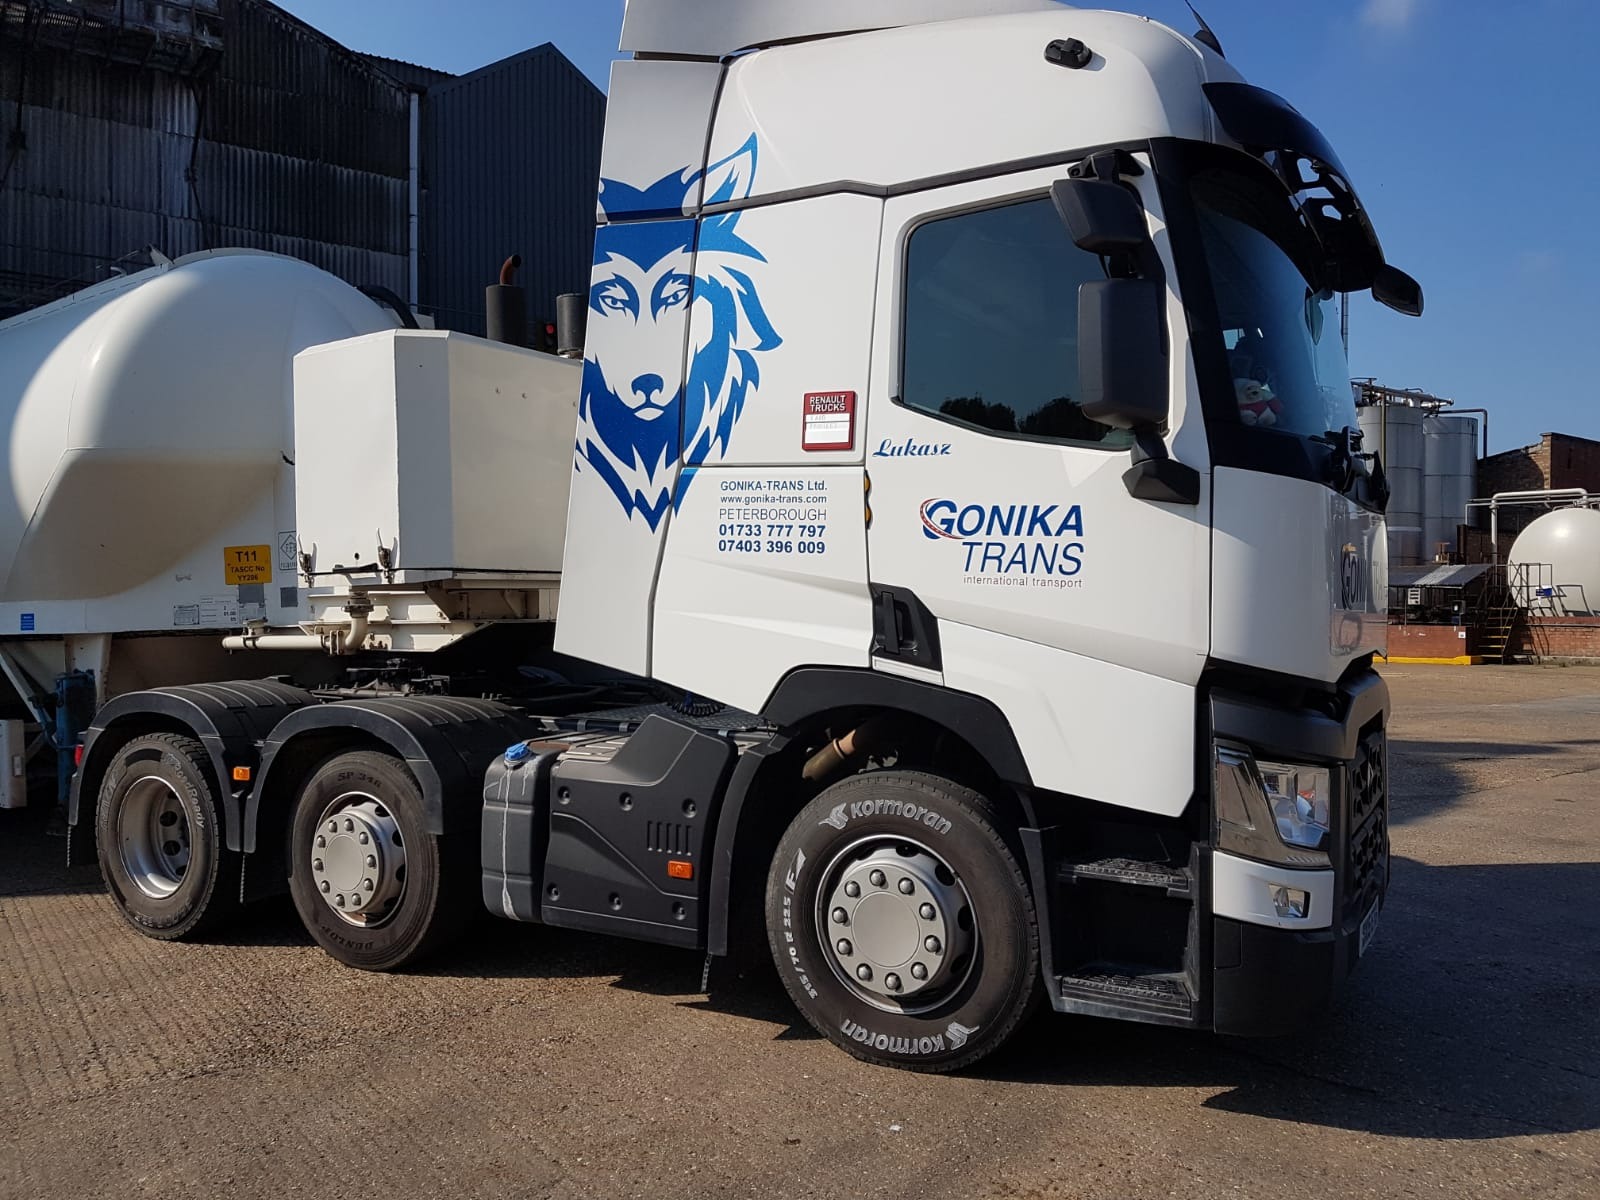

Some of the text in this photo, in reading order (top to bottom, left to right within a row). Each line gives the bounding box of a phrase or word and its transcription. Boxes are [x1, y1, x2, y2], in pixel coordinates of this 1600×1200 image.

[810, 395, 846, 405] RENAULT
[810, 403, 846, 412] TRUCKS
[872, 438, 952, 457] Lukasz
[720, 480, 828, 491] GONIKA-TRANS Ltd.
[720, 494, 827, 505] www.gonika-trans.com
[719, 508, 827, 520] PETERBOROUGH
[920, 498, 1084, 540] GONIKA
[719, 524, 826, 537] 01733 777 797
[718, 540, 826, 553] 07403 396 009
[235, 550, 257, 562] T11
[962, 541, 1085, 576] TRANS
[963, 575, 1083, 589] international transport
